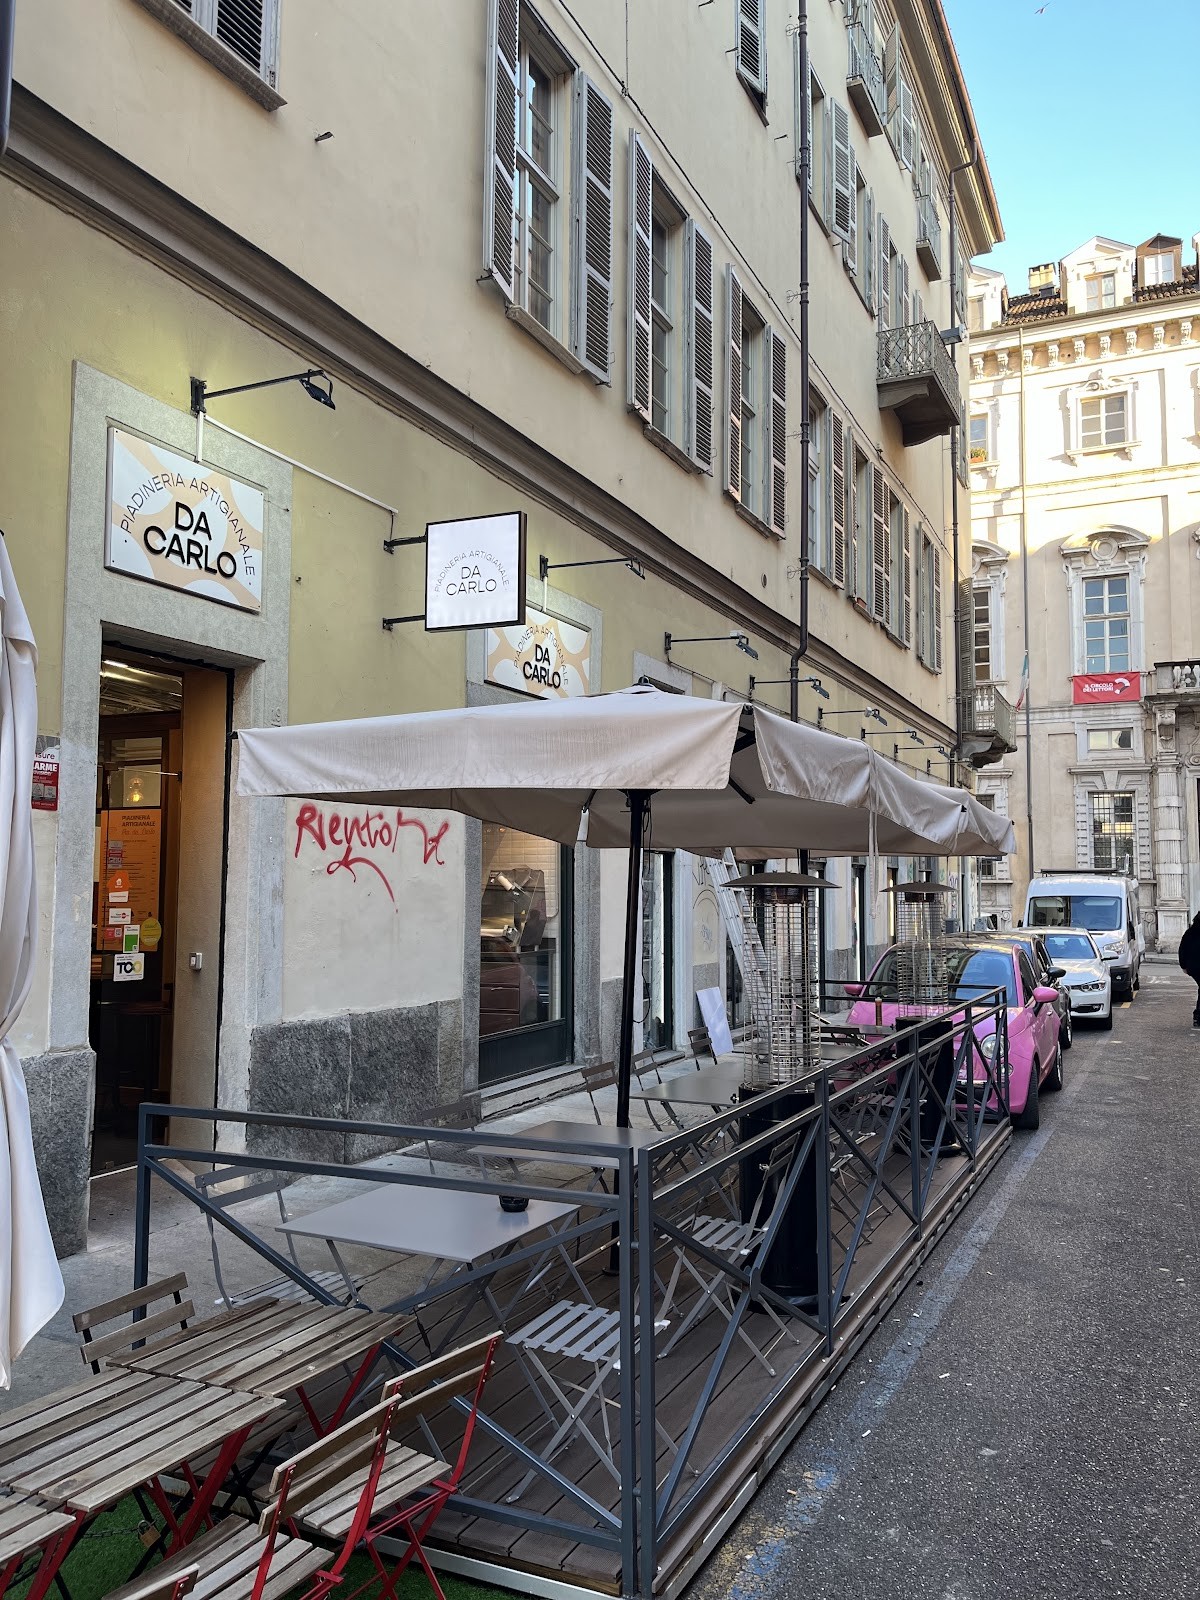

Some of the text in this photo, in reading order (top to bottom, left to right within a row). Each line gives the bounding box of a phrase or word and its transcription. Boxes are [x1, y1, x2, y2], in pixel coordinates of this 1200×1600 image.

[121, 472, 256, 577] PIADINERIA ARTIGIANALE
[175, 501, 212, 541] DA
[143, 525, 237, 578] CARLO
[434, 550, 510, 592] PIADINERIA ARTIGIANALE
[446, 578, 497, 596] CARLO
[461, 565, 481, 579] DA
[513, 625, 539, 668] PIADINERIA
[535, 643, 551, 666] DA
[522, 661, 561, 689] CARLO
[34, 761, 58, 772] ARME
